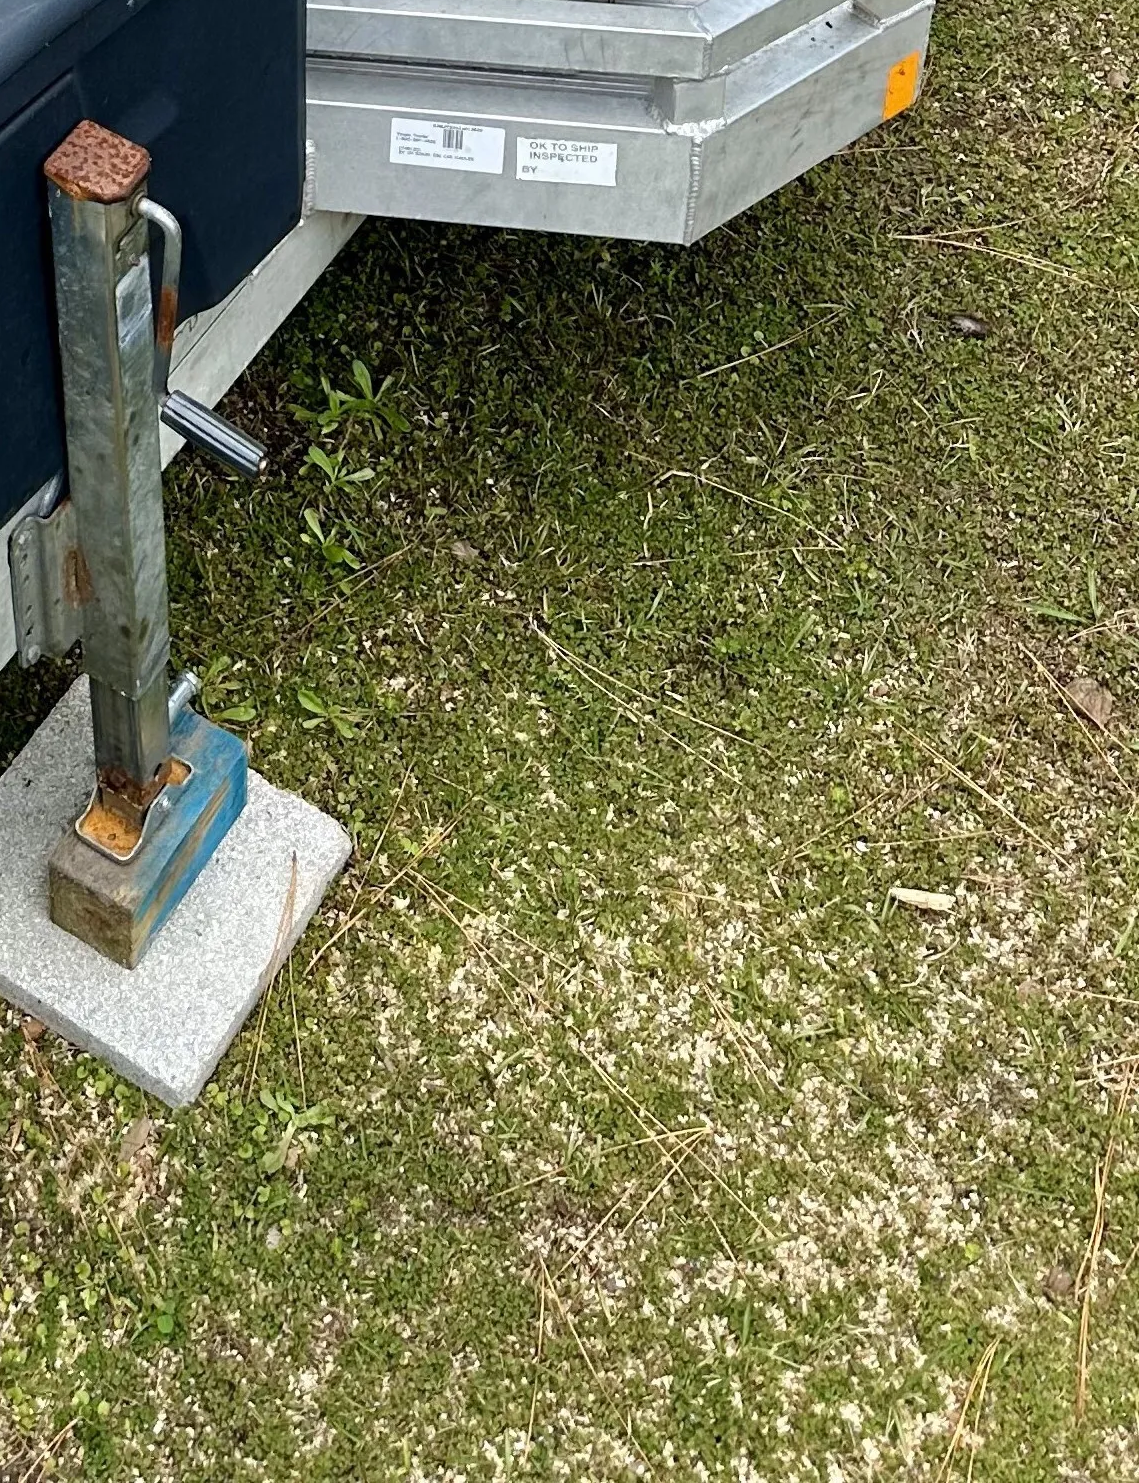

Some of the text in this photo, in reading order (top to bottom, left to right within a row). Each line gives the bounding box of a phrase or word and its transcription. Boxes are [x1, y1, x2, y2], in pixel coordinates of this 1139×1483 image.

[529, 141, 599, 153] OK TO SHIP
[529, 152, 598, 163] INSPECTED
[521, 165, 537, 173] BY
